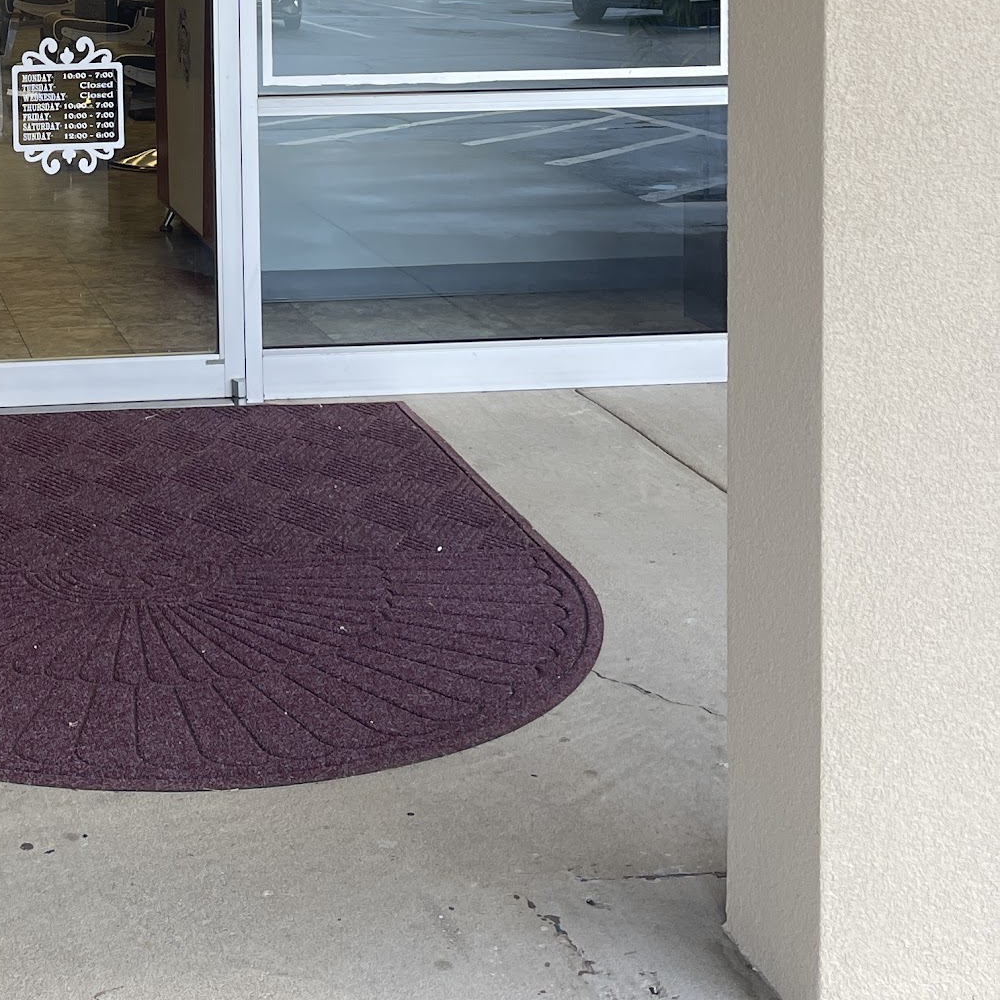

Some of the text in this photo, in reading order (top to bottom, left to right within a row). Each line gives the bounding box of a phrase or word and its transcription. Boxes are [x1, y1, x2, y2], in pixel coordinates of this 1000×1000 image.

[62, 72, 87, 80] 10:00
[95, 71, 114, 79] 7:00
[79, 81, 114, 89] Closed
[79, 91, 114, 99] Closed
[95, 101, 114, 109] 7:00
[64, 112, 87, 120] 10:00
[95, 111, 115, 119] 7:00
[64, 122, 88, 130] 10:00
[95, 121, 115, 129] 7:00
[64, 132, 88, 140] 12:00
[96, 131, 115, 139] 6:00
